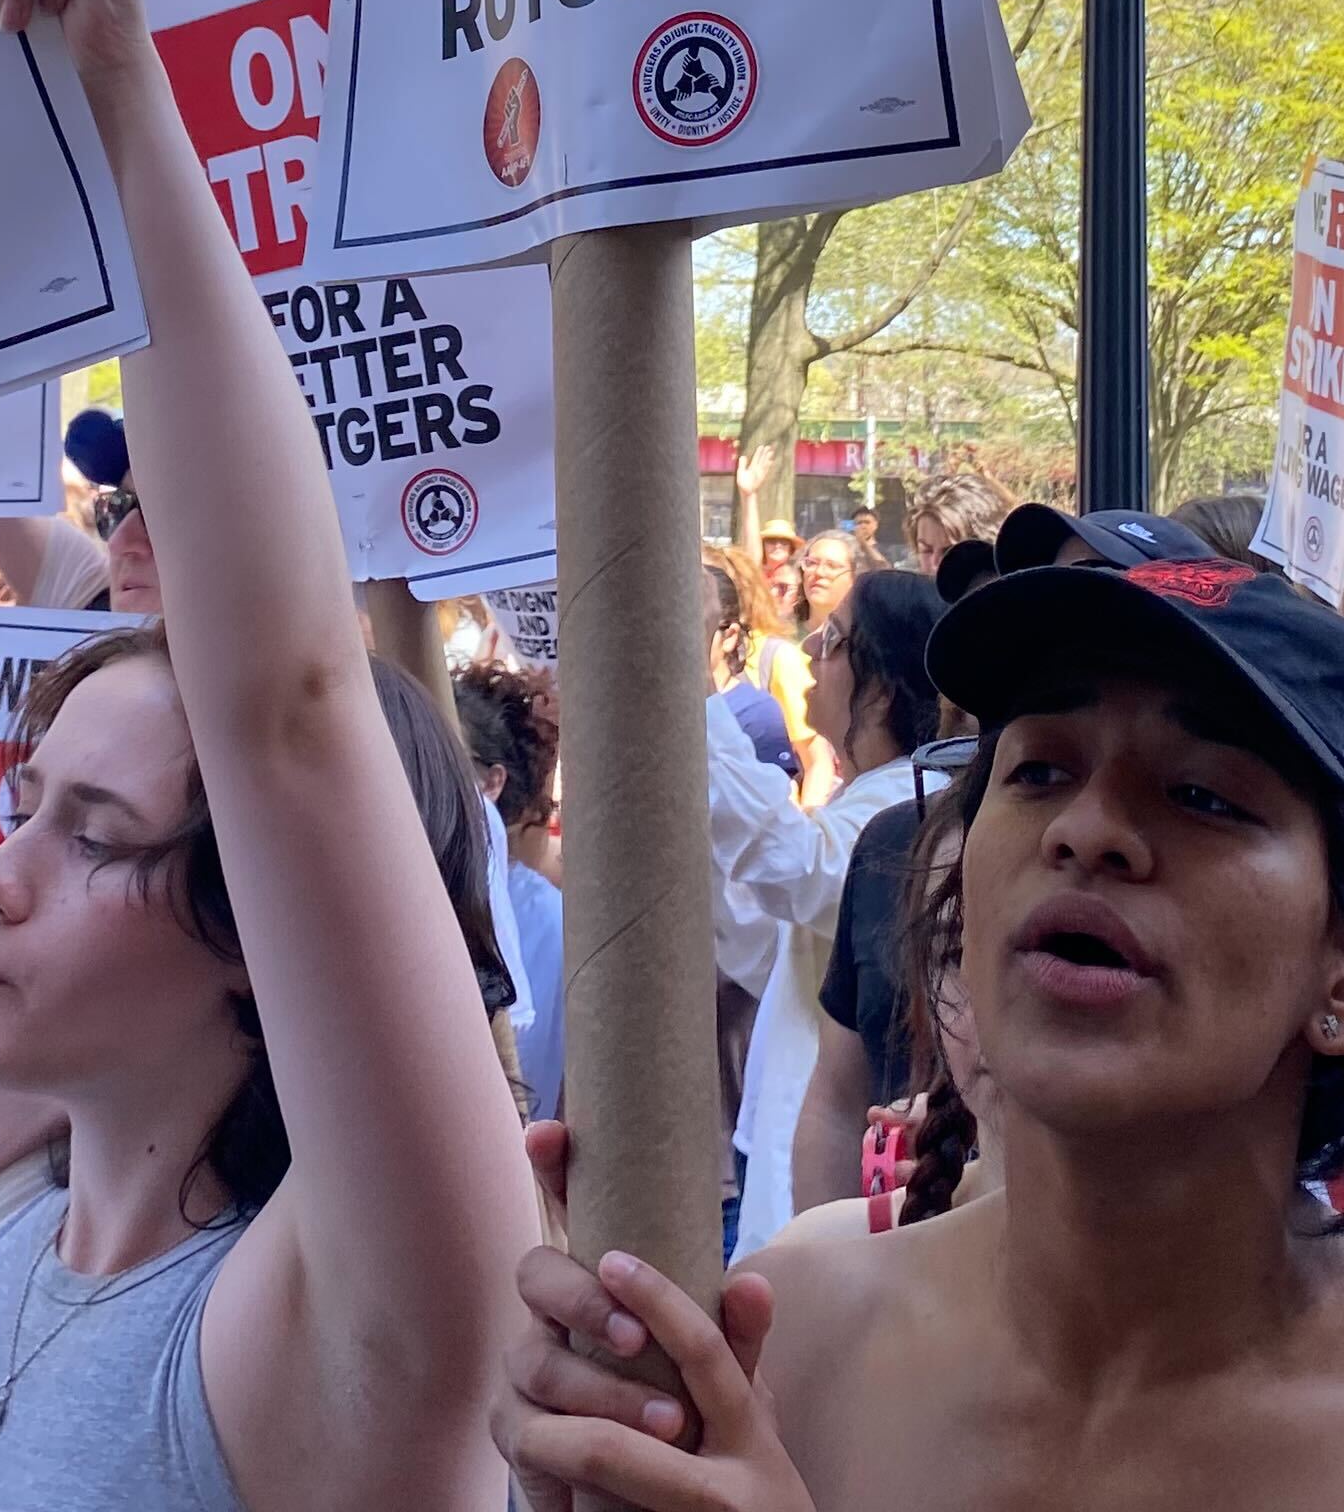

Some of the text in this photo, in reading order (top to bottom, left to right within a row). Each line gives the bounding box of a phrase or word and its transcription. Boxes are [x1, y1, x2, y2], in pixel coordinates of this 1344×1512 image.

[643, 23, 746, 94] RUTGERS ADJUNCT FACULTY UNION
[649, 107, 672, 129] UNITY
[262, 278, 428, 343] FOR A
[287, 323, 469, 408] ETTER
[311, 384, 502, 471] TGERS
[1314, 430, 1328, 465] A
